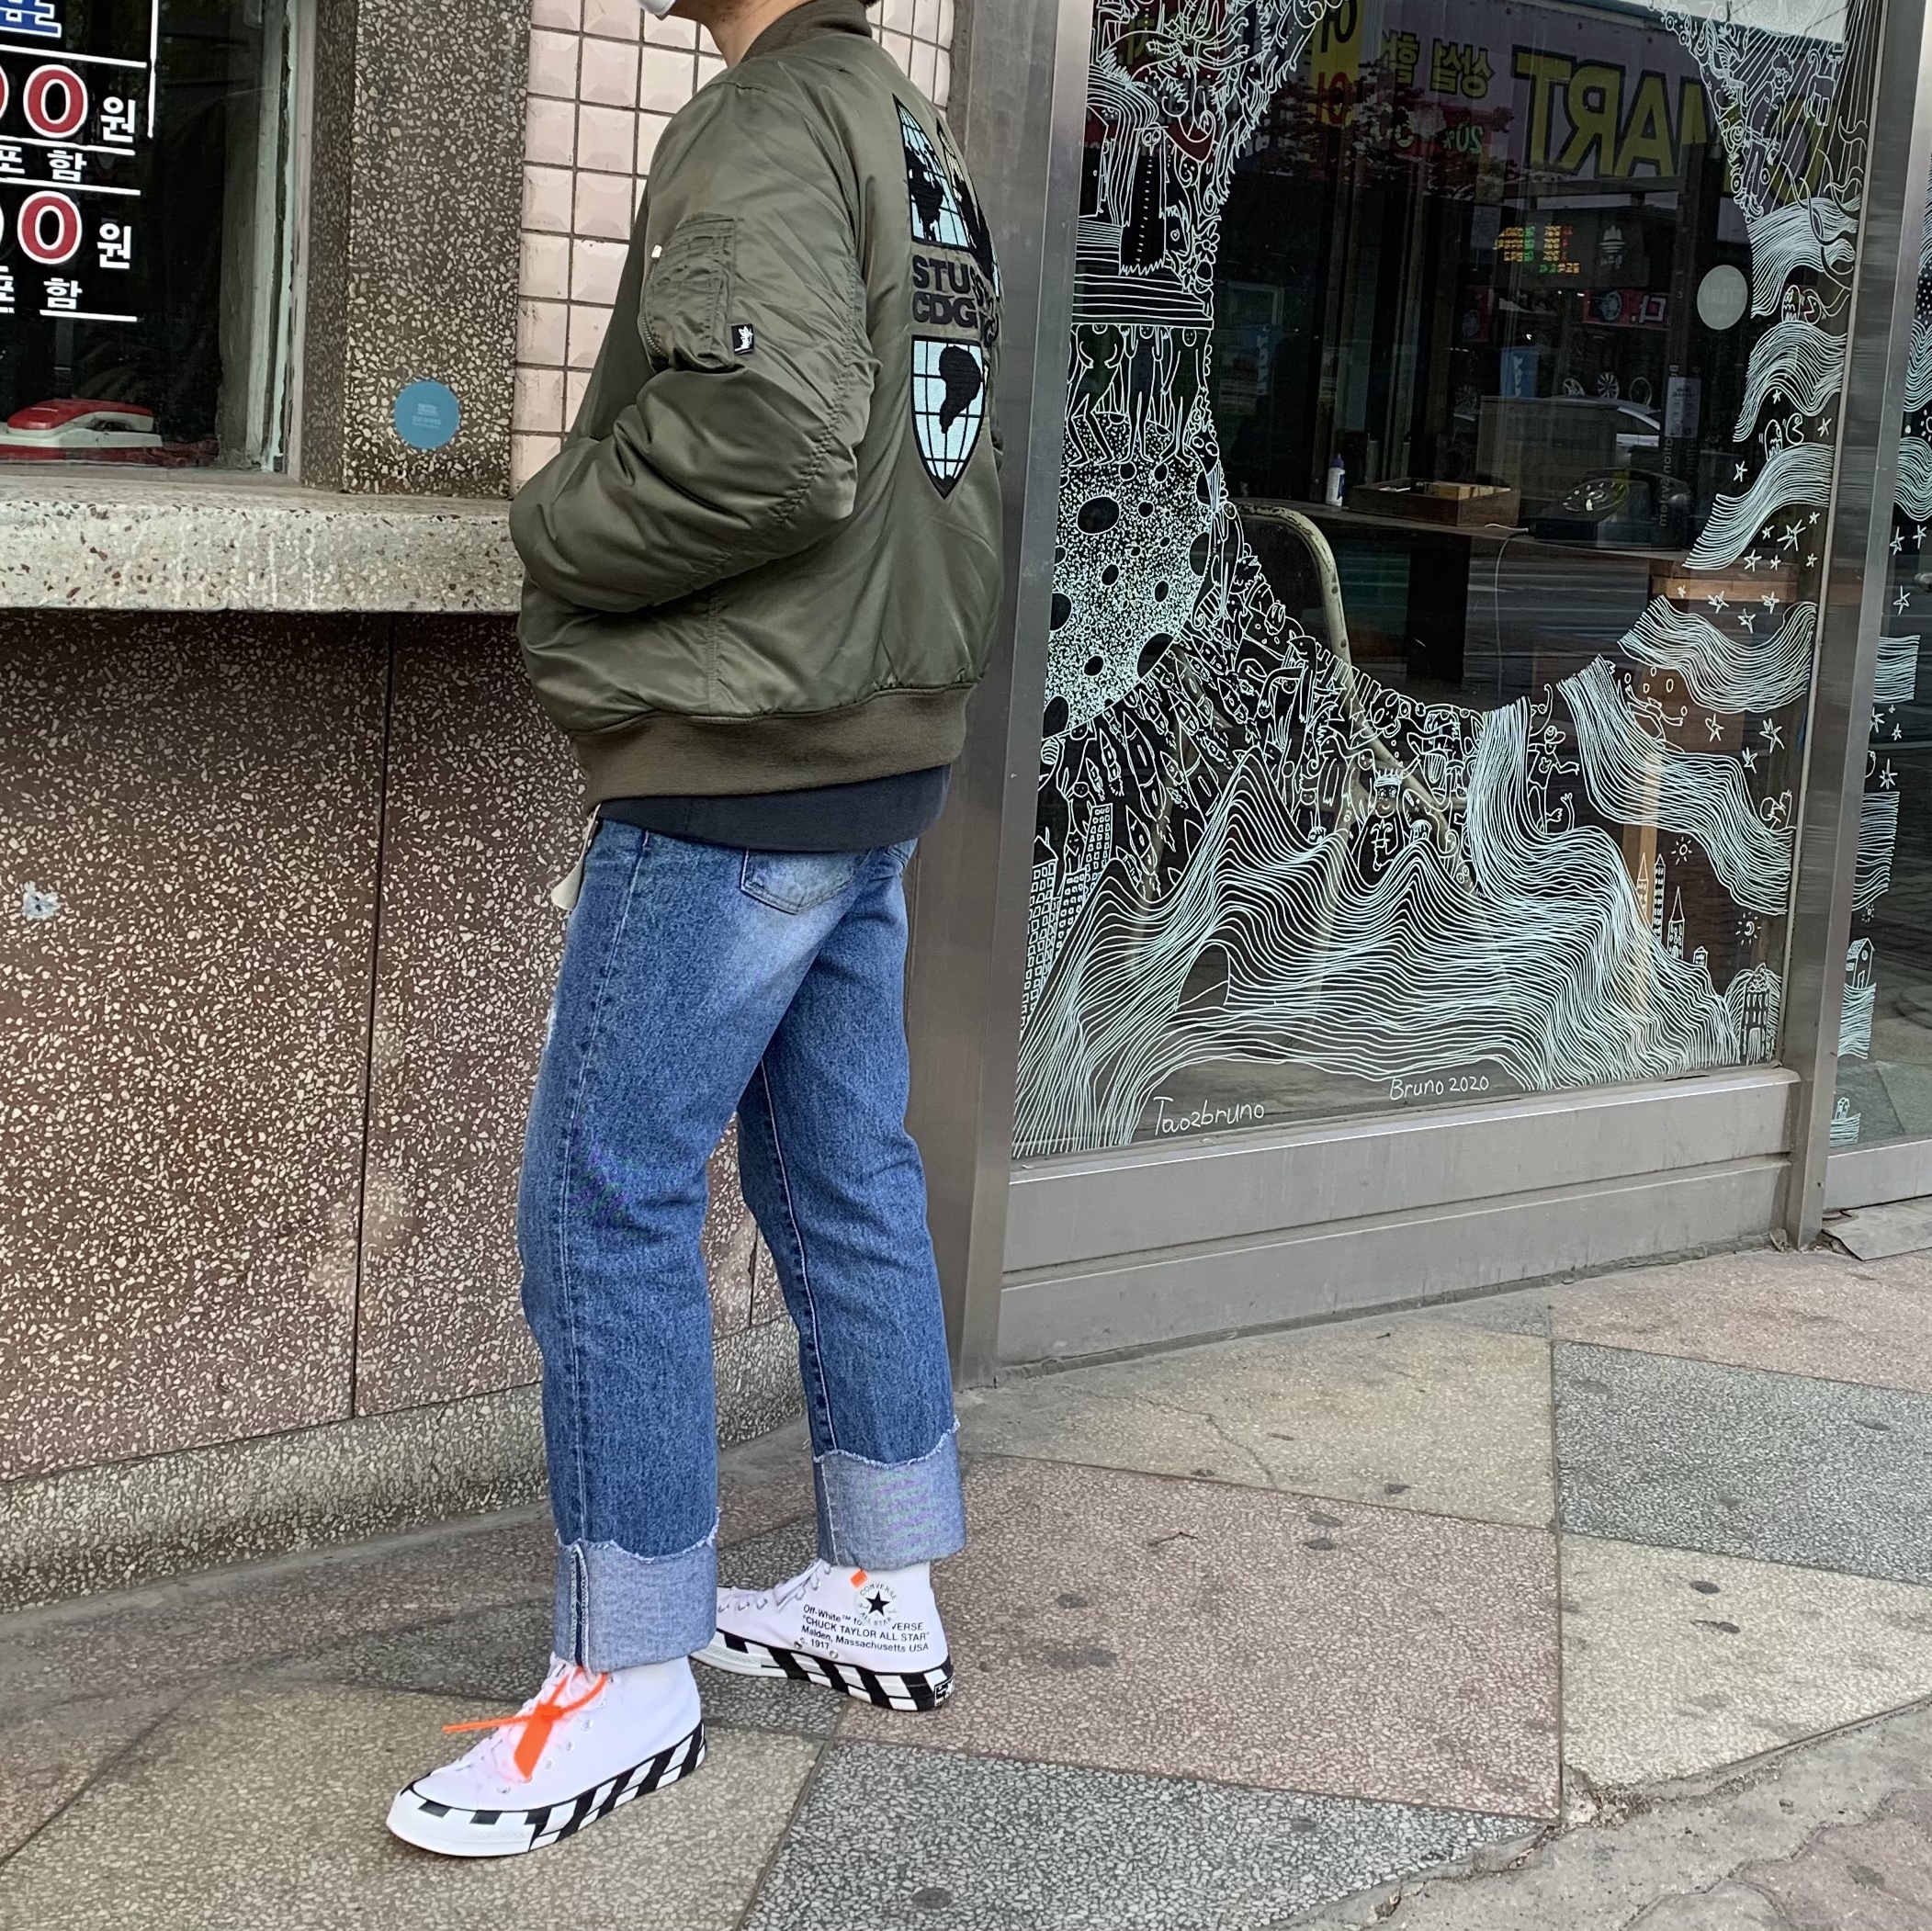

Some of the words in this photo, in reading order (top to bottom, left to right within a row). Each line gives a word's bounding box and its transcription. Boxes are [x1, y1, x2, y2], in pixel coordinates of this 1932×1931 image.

[1388, 1078, 1444, 1101] Bruno
[1449, 1076, 1490, 1092] 2020
[840, 1625, 876, 1639] TAYLOR
[879, 1632, 898, 1642] ALL
[810, 1639, 830, 1650] 1917
[835, 1635, 906, 1653] Massachusetts
[909, 1643, 929, 1653] USA
